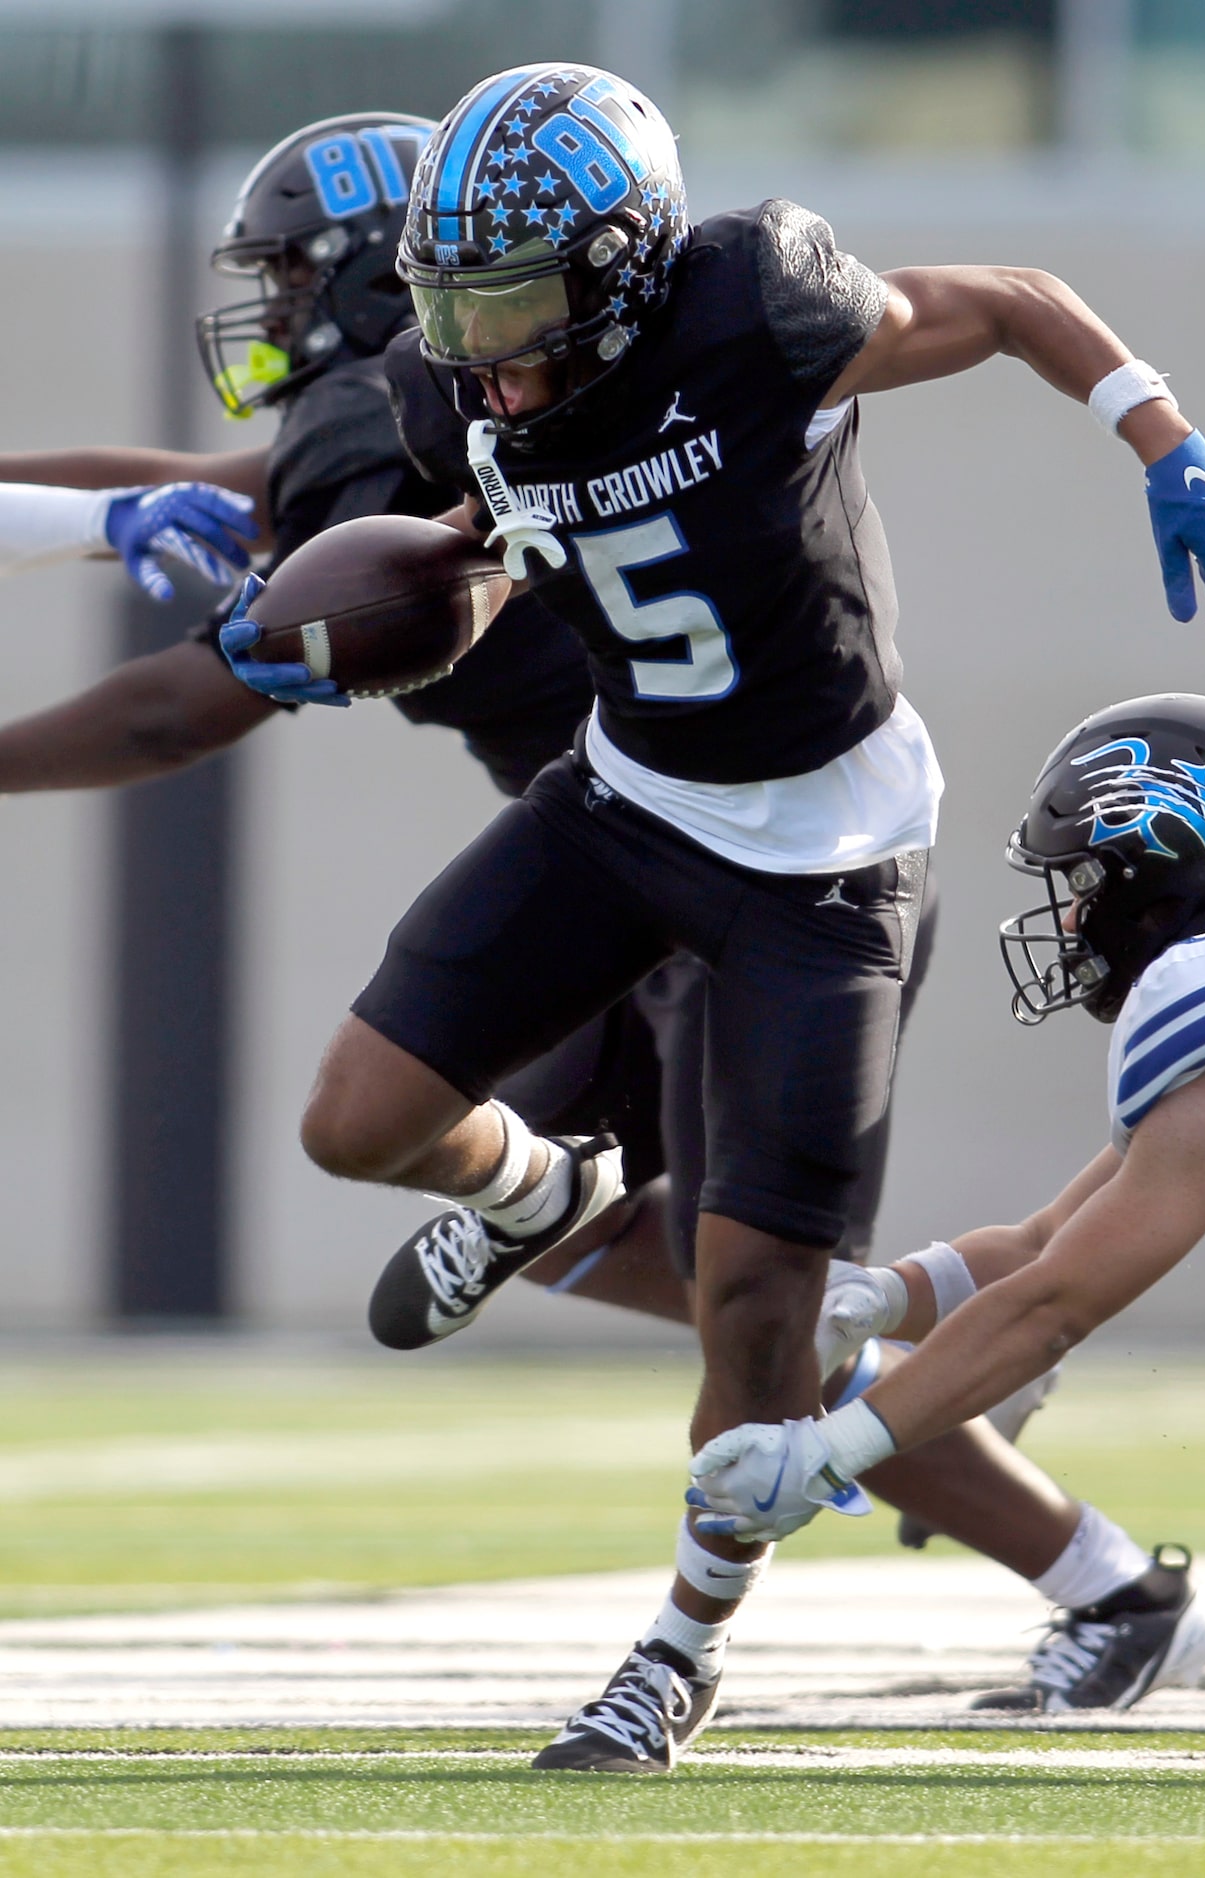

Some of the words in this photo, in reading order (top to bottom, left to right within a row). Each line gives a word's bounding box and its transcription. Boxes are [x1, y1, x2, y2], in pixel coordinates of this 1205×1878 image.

[477, 464, 513, 517] NXTRND
[587, 429, 723, 518] CROWLEY
[568, 509, 741, 702] 5
